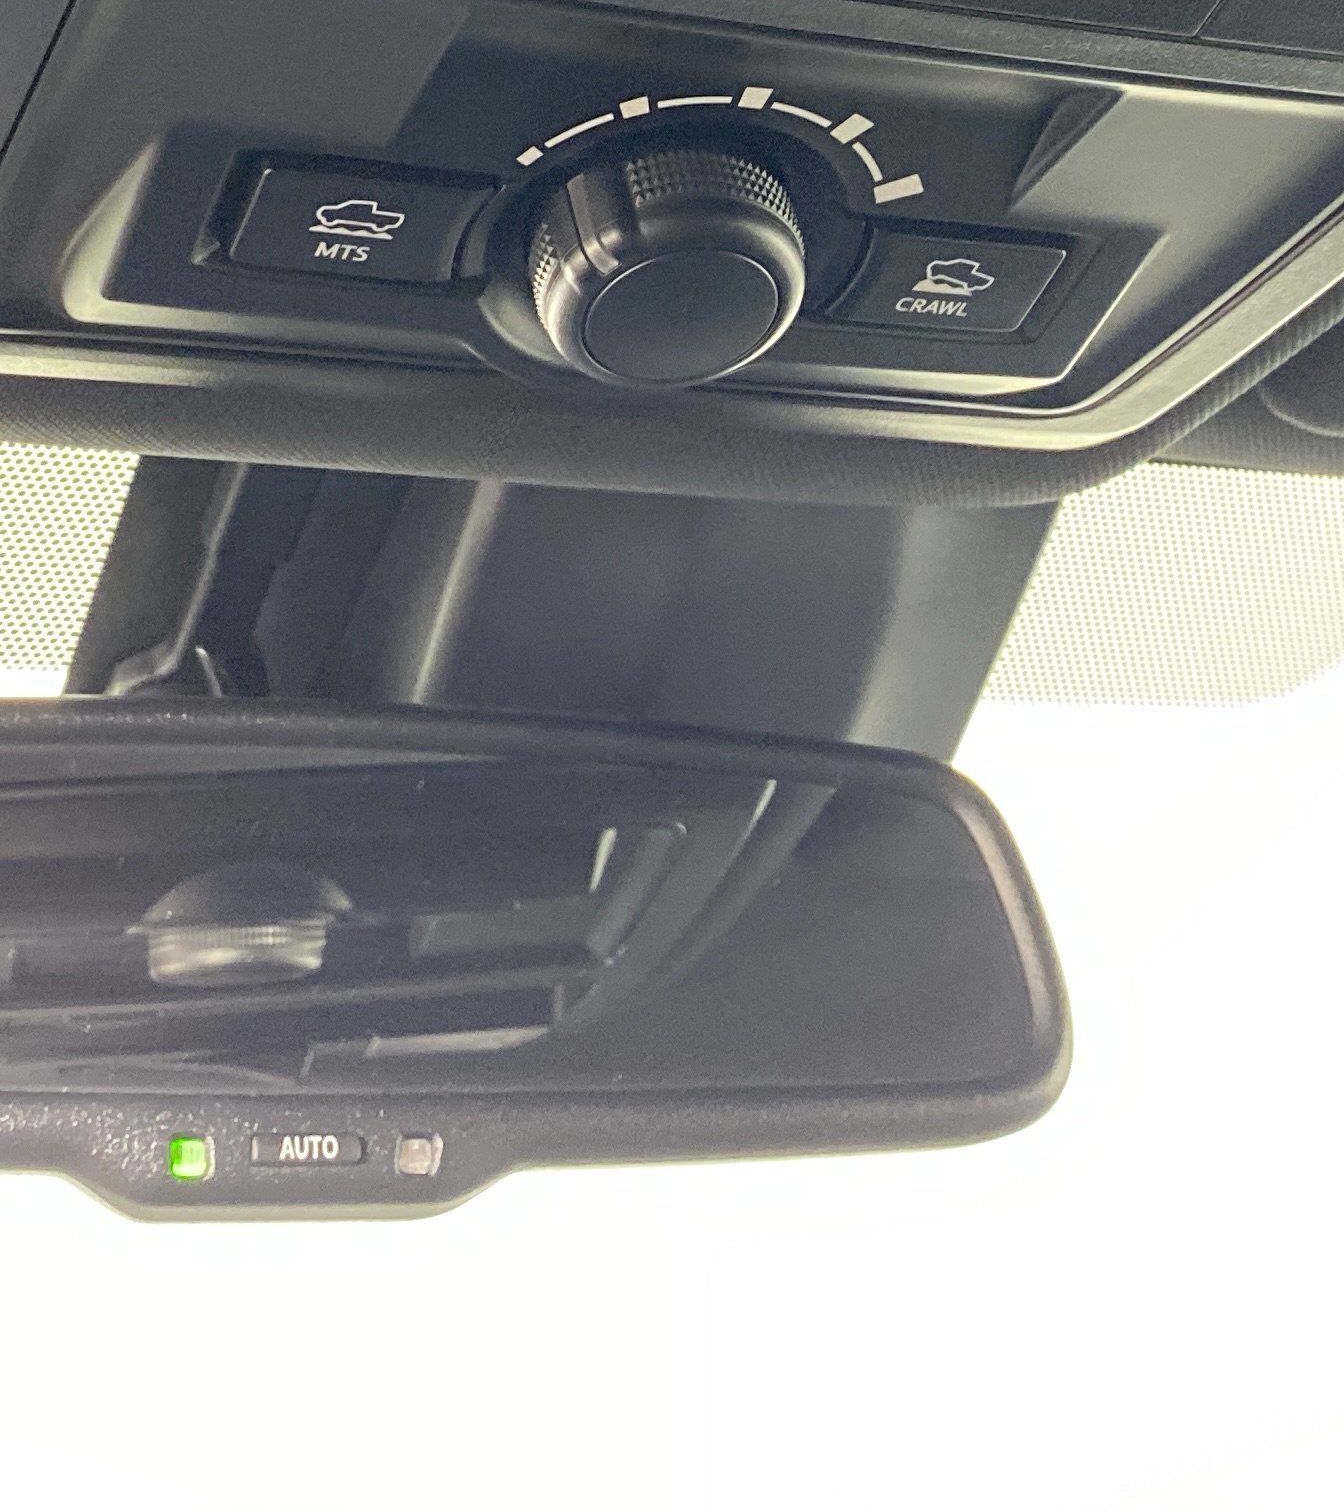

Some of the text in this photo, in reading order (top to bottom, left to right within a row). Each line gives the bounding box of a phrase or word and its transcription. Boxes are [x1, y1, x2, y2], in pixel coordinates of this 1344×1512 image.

[314, 241, 370, 262] MTS
[895, 297, 970, 317] CRAWL
[279, 1135, 339, 1160] AUTO
